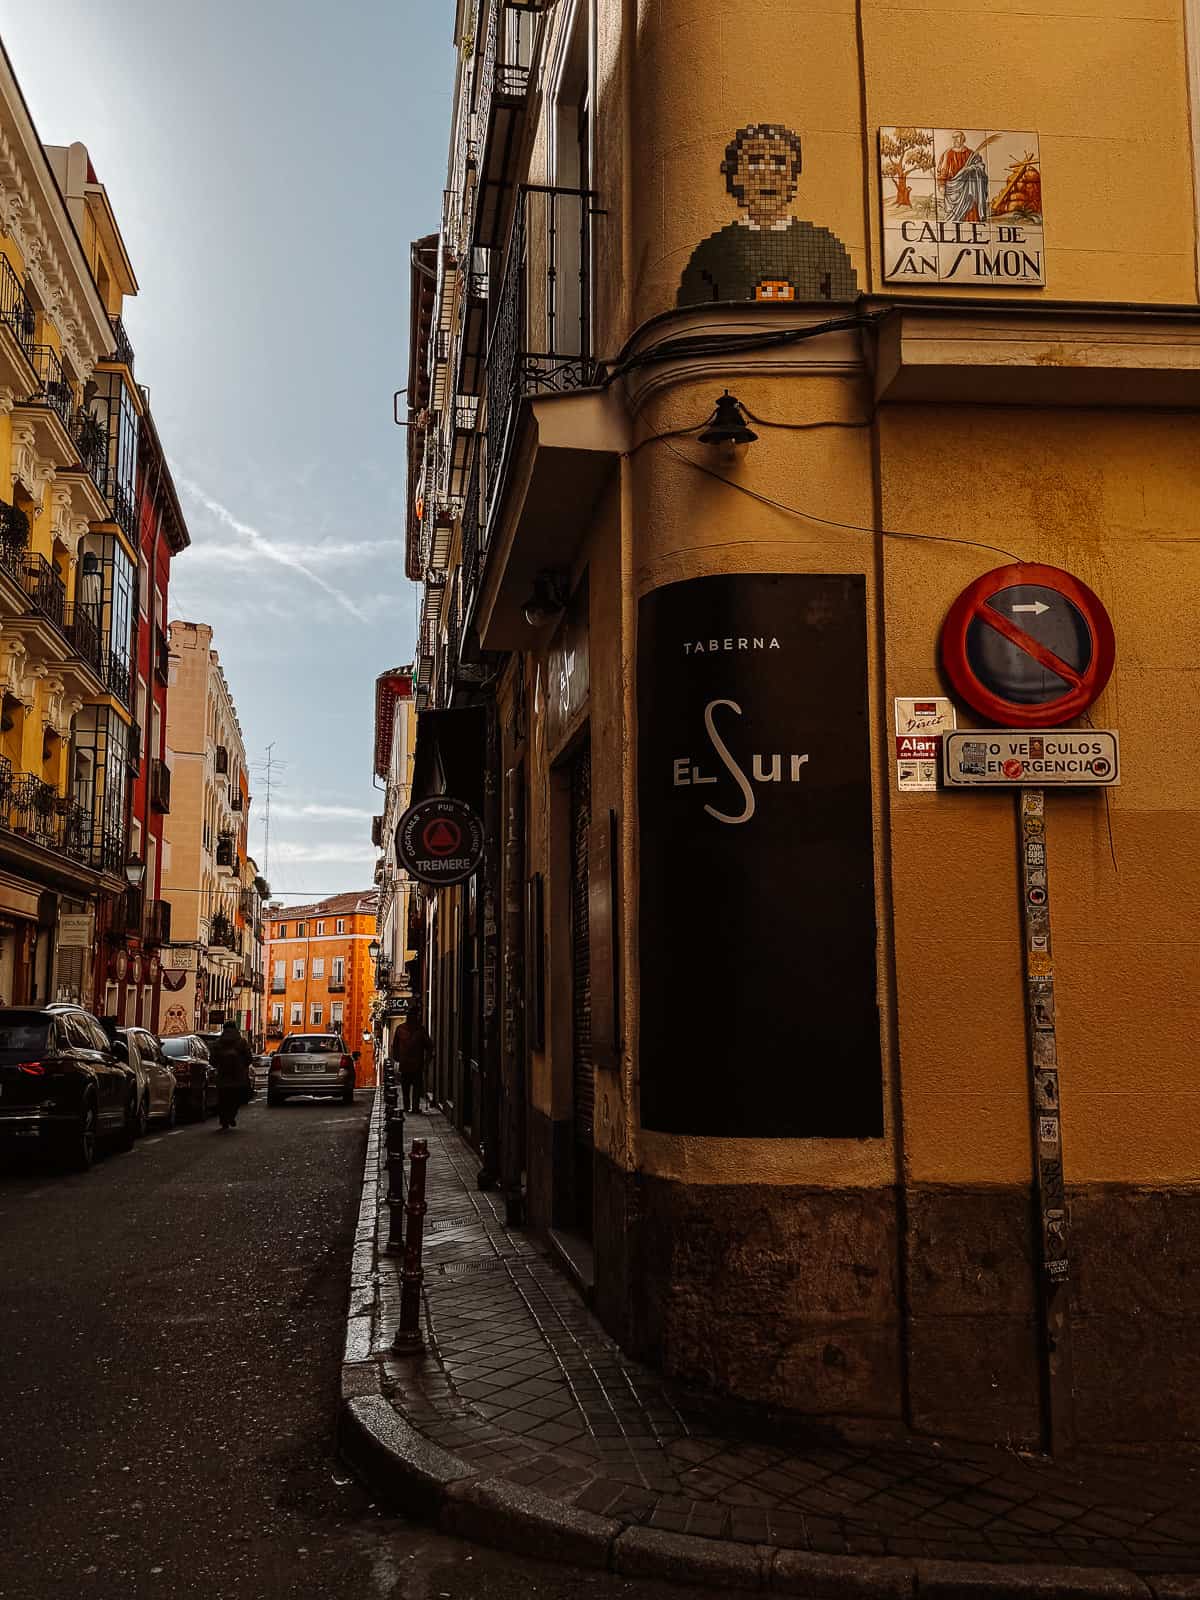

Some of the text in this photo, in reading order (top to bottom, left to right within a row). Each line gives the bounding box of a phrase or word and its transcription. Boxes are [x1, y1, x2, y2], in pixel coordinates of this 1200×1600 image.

[901, 220, 1026, 244] CALLE DE
[887, 246, 1041, 279] SAN SIMON
[683, 637, 780, 655] TABERNA
[704, 699, 809, 824] Sur
[415, 858, 471, 872] TREMERE
